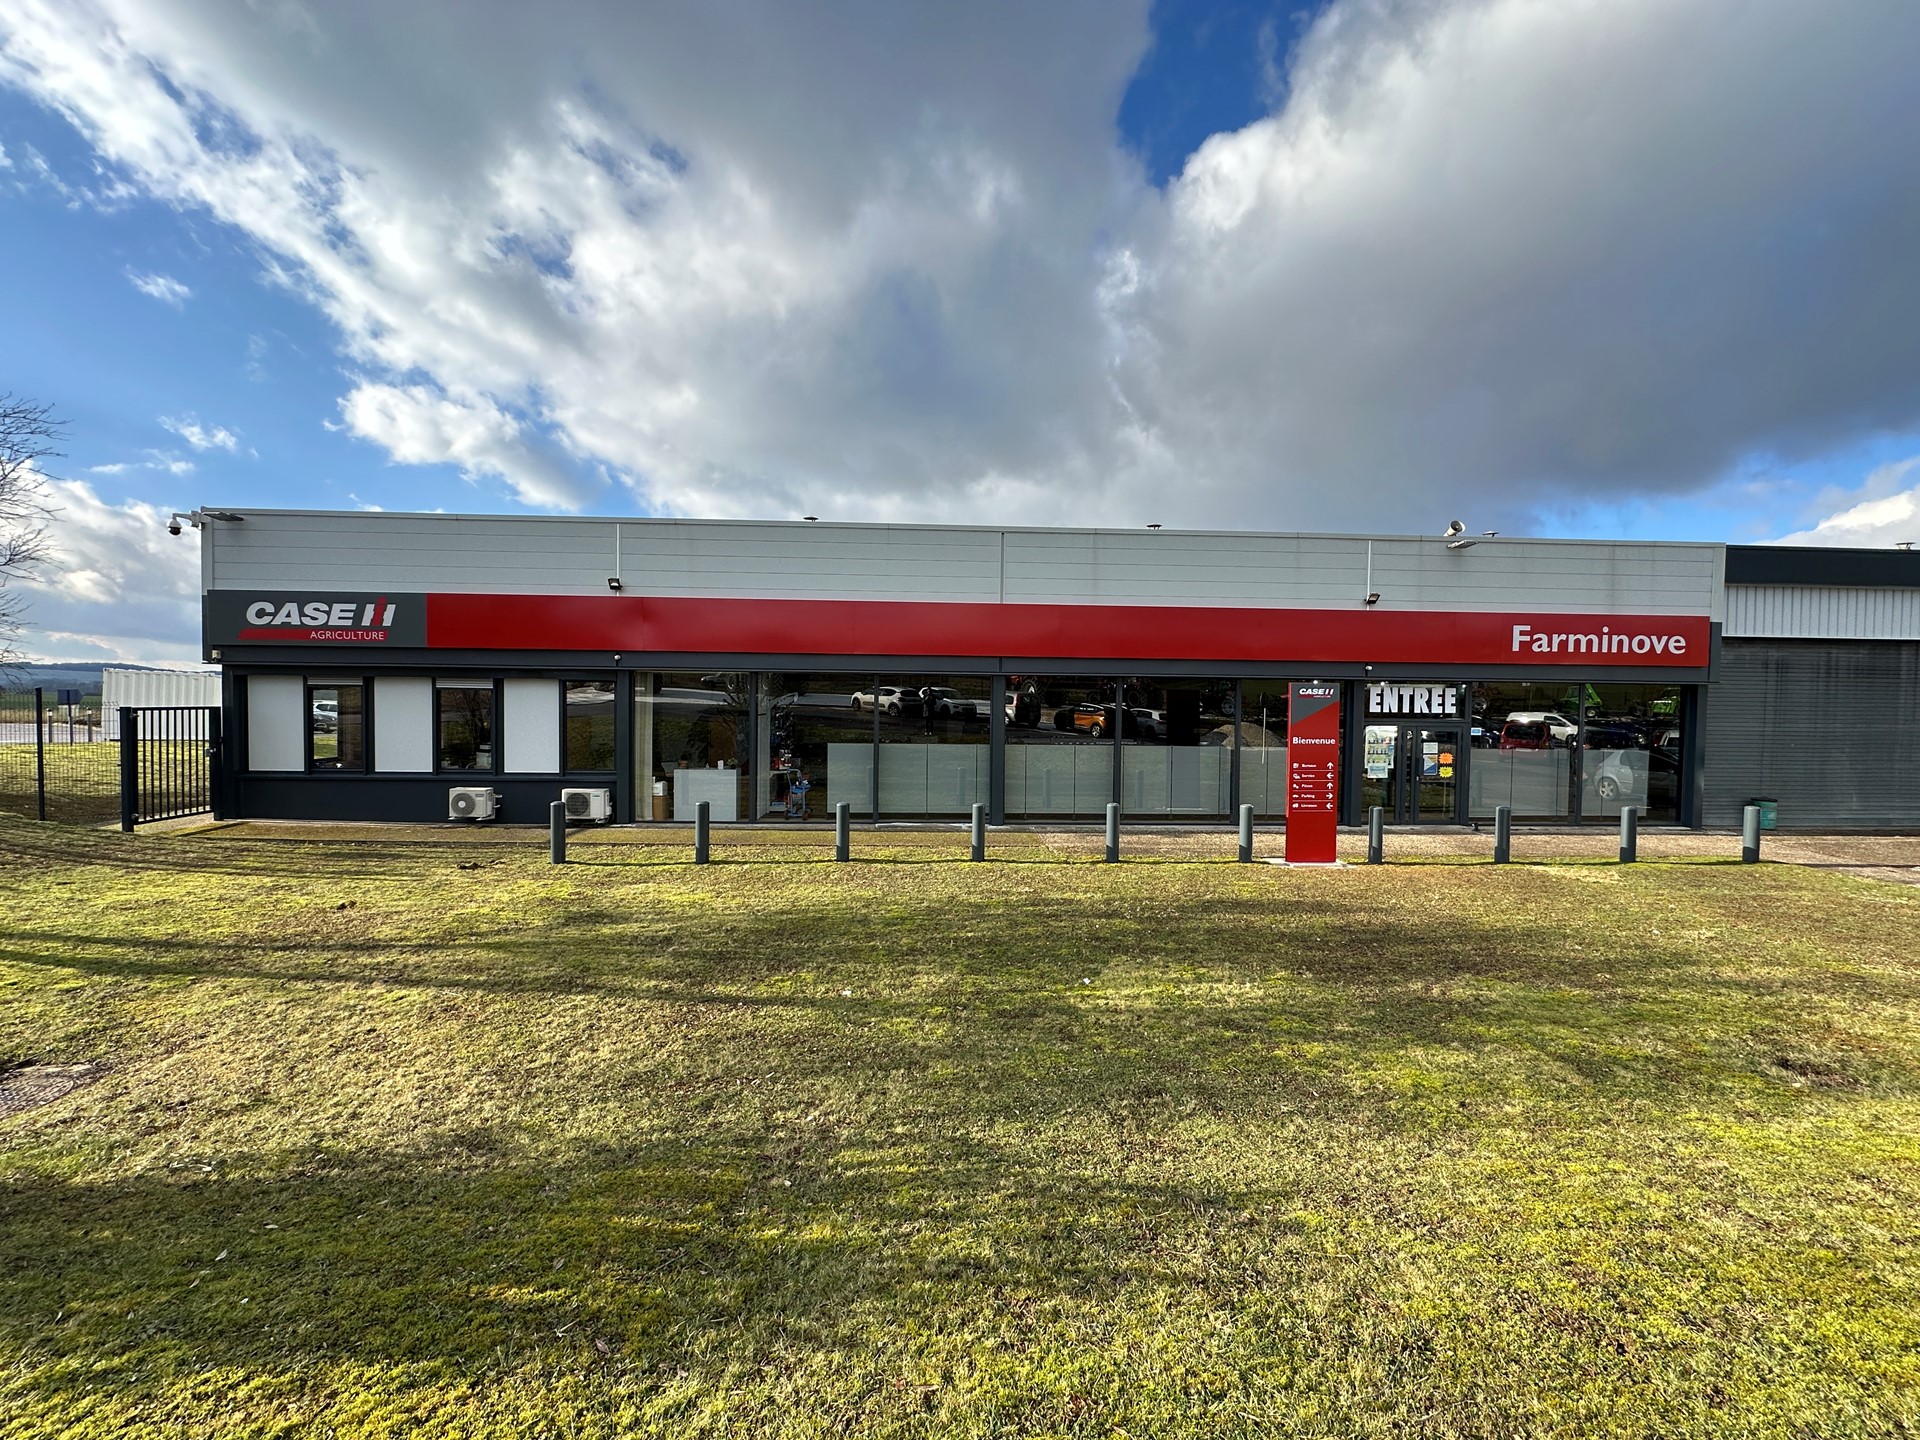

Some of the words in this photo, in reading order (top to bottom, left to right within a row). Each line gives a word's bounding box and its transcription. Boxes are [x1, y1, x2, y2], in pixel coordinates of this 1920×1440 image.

[246, 601, 357, 626] CASE
[310, 630, 384, 640] AGRICULTURE
[1512, 625, 1686, 654] Farminove
[1369, 687, 1457, 714] ENTREE
[1292, 736, 1336, 745] Bienvenue
